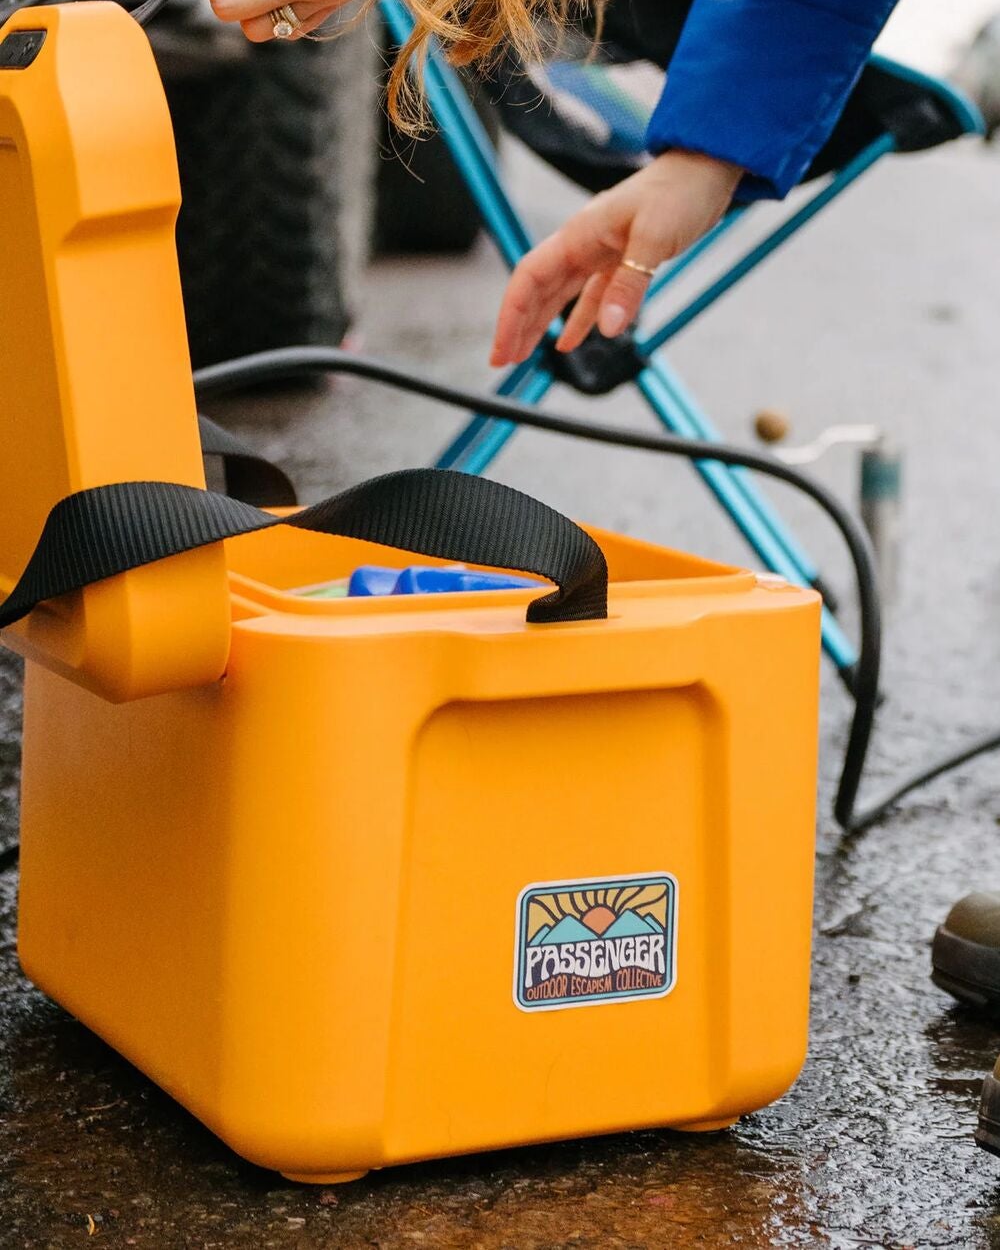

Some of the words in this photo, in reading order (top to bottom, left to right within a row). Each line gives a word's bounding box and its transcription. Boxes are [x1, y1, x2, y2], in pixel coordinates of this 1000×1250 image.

[525, 934, 666, 988] PASSENGER
[527, 975, 568, 1000] OUTDOOR
[571, 975, 612, 995] ESCAPISM
[616, 968, 662, 990] COLLECTIVE
